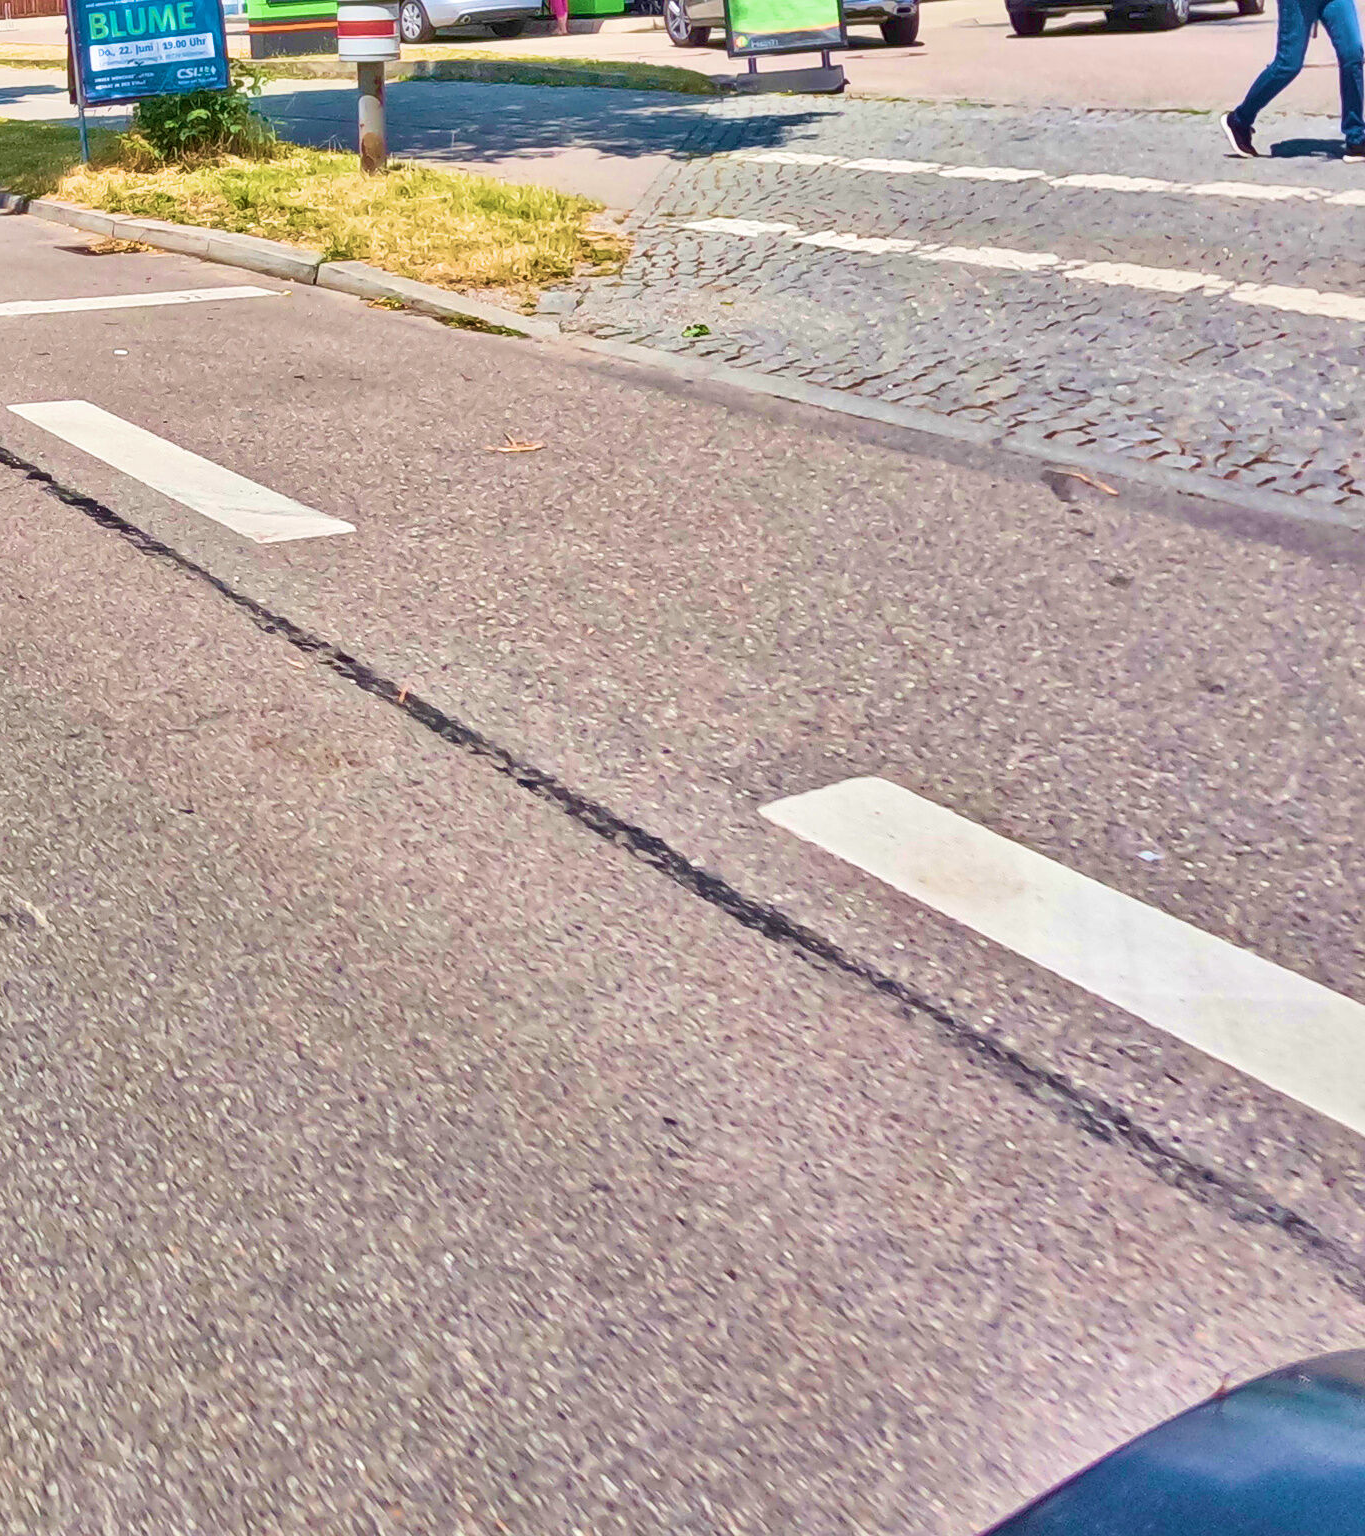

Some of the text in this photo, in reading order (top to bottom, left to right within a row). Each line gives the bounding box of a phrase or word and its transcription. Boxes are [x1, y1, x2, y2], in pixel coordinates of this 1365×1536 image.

[88, 1, 196, 40] BLUME
[136, 44, 153, 55] Juni
[163, 40, 187, 50] 19.00
[189, 37, 206, 46] Uhr
